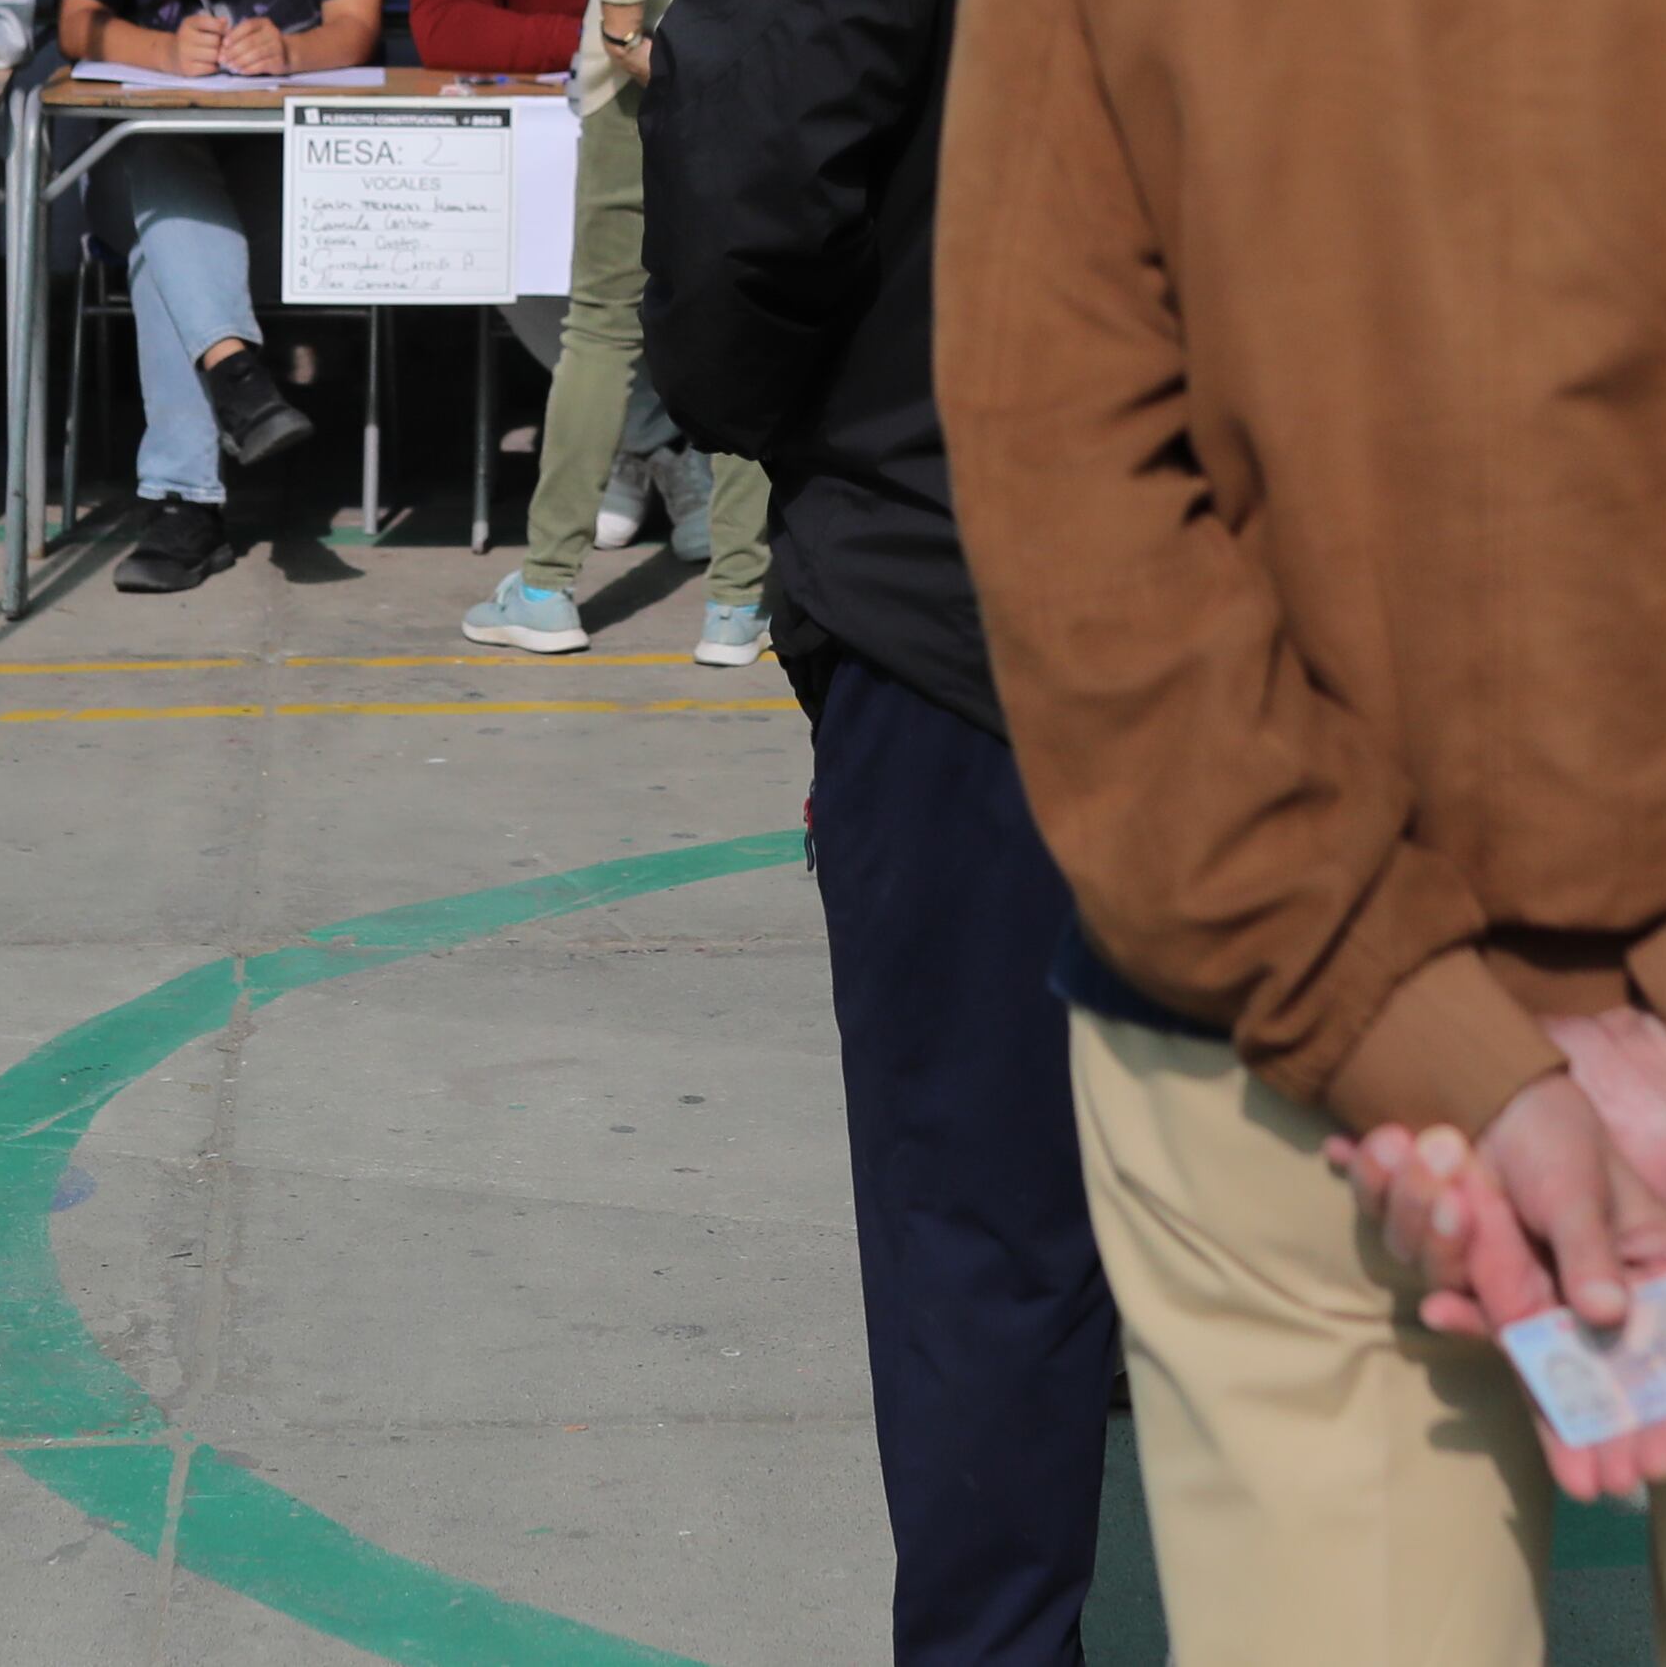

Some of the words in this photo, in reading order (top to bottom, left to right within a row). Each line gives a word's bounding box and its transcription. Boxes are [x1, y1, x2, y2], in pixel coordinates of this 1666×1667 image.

[307, 140, 403, 166] MESA:
[422, 136, 459, 166] 2
[361, 176, 441, 191] VOCALES
[299, 217, 309, 231] 2
[300, 235, 309, 248] 3
[299, 255, 309, 268] 4
[299, 275, 309, 289] 5
